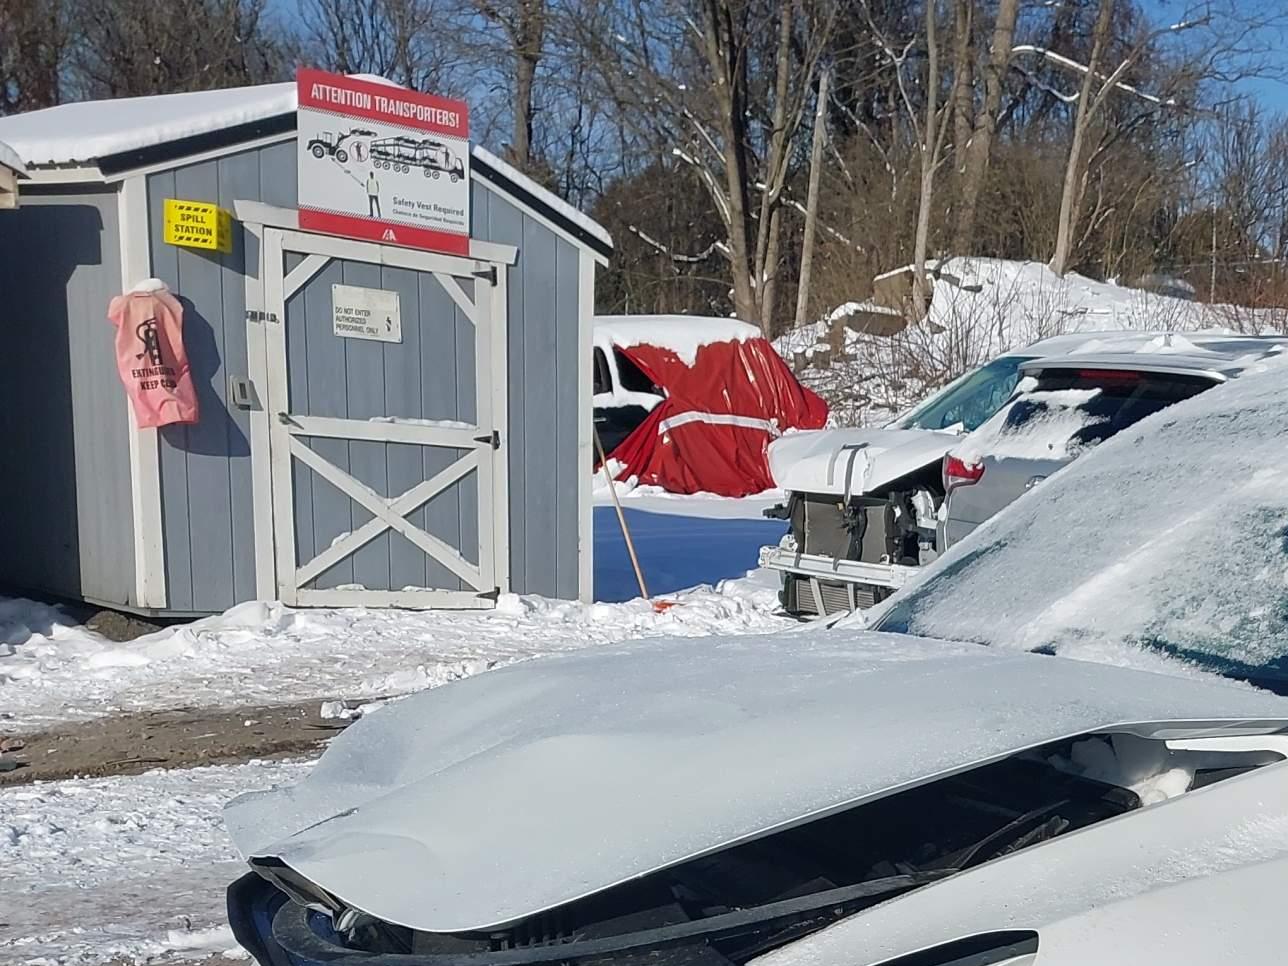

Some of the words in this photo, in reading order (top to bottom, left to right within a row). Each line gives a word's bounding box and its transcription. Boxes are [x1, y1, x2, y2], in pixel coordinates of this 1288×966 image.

[311, 83, 372, 110] ATTENTION
[375, 96, 459, 128] TRANSPORTERS!
[393, 196, 415, 209] Safety
[416, 201, 432, 210] Vest
[433, 204, 465, 216] Required
[180, 213, 206, 224] SPILL
[174, 223, 213, 237] STATION
[335, 306, 343, 314] DO
[344, 307, 354, 316] NOT
[355, 308, 371, 318] ENTER
[335, 315, 367, 325] AUTHORIZED
[140, 380, 159, 390] KEEP
